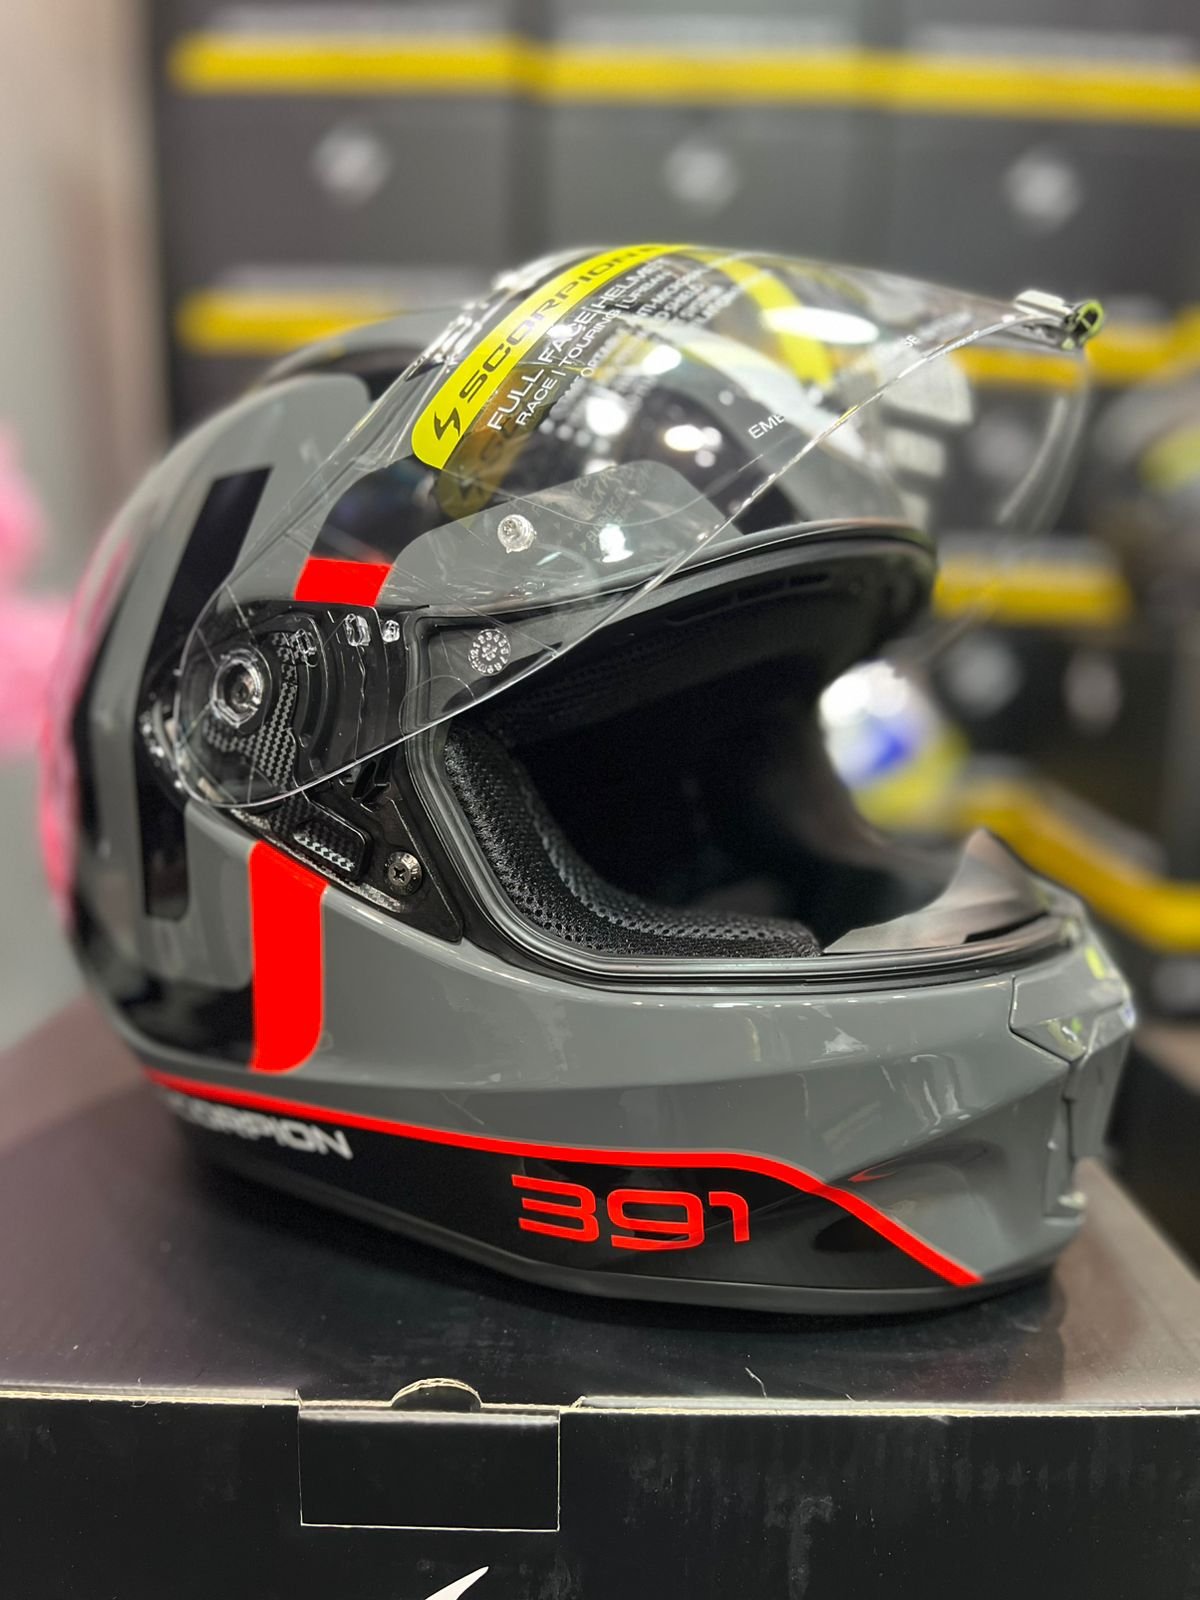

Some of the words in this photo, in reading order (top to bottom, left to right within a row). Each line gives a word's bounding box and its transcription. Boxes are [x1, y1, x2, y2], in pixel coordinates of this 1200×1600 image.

[459, 252, 637, 403] SCORPION
[487, 368, 544, 431] FULL
[538, 310, 596, 364] FACE
[515, 378, 558, 426] RACE
[559, 311, 619, 368] TOURING
[511, 1174, 751, 1252] 391
